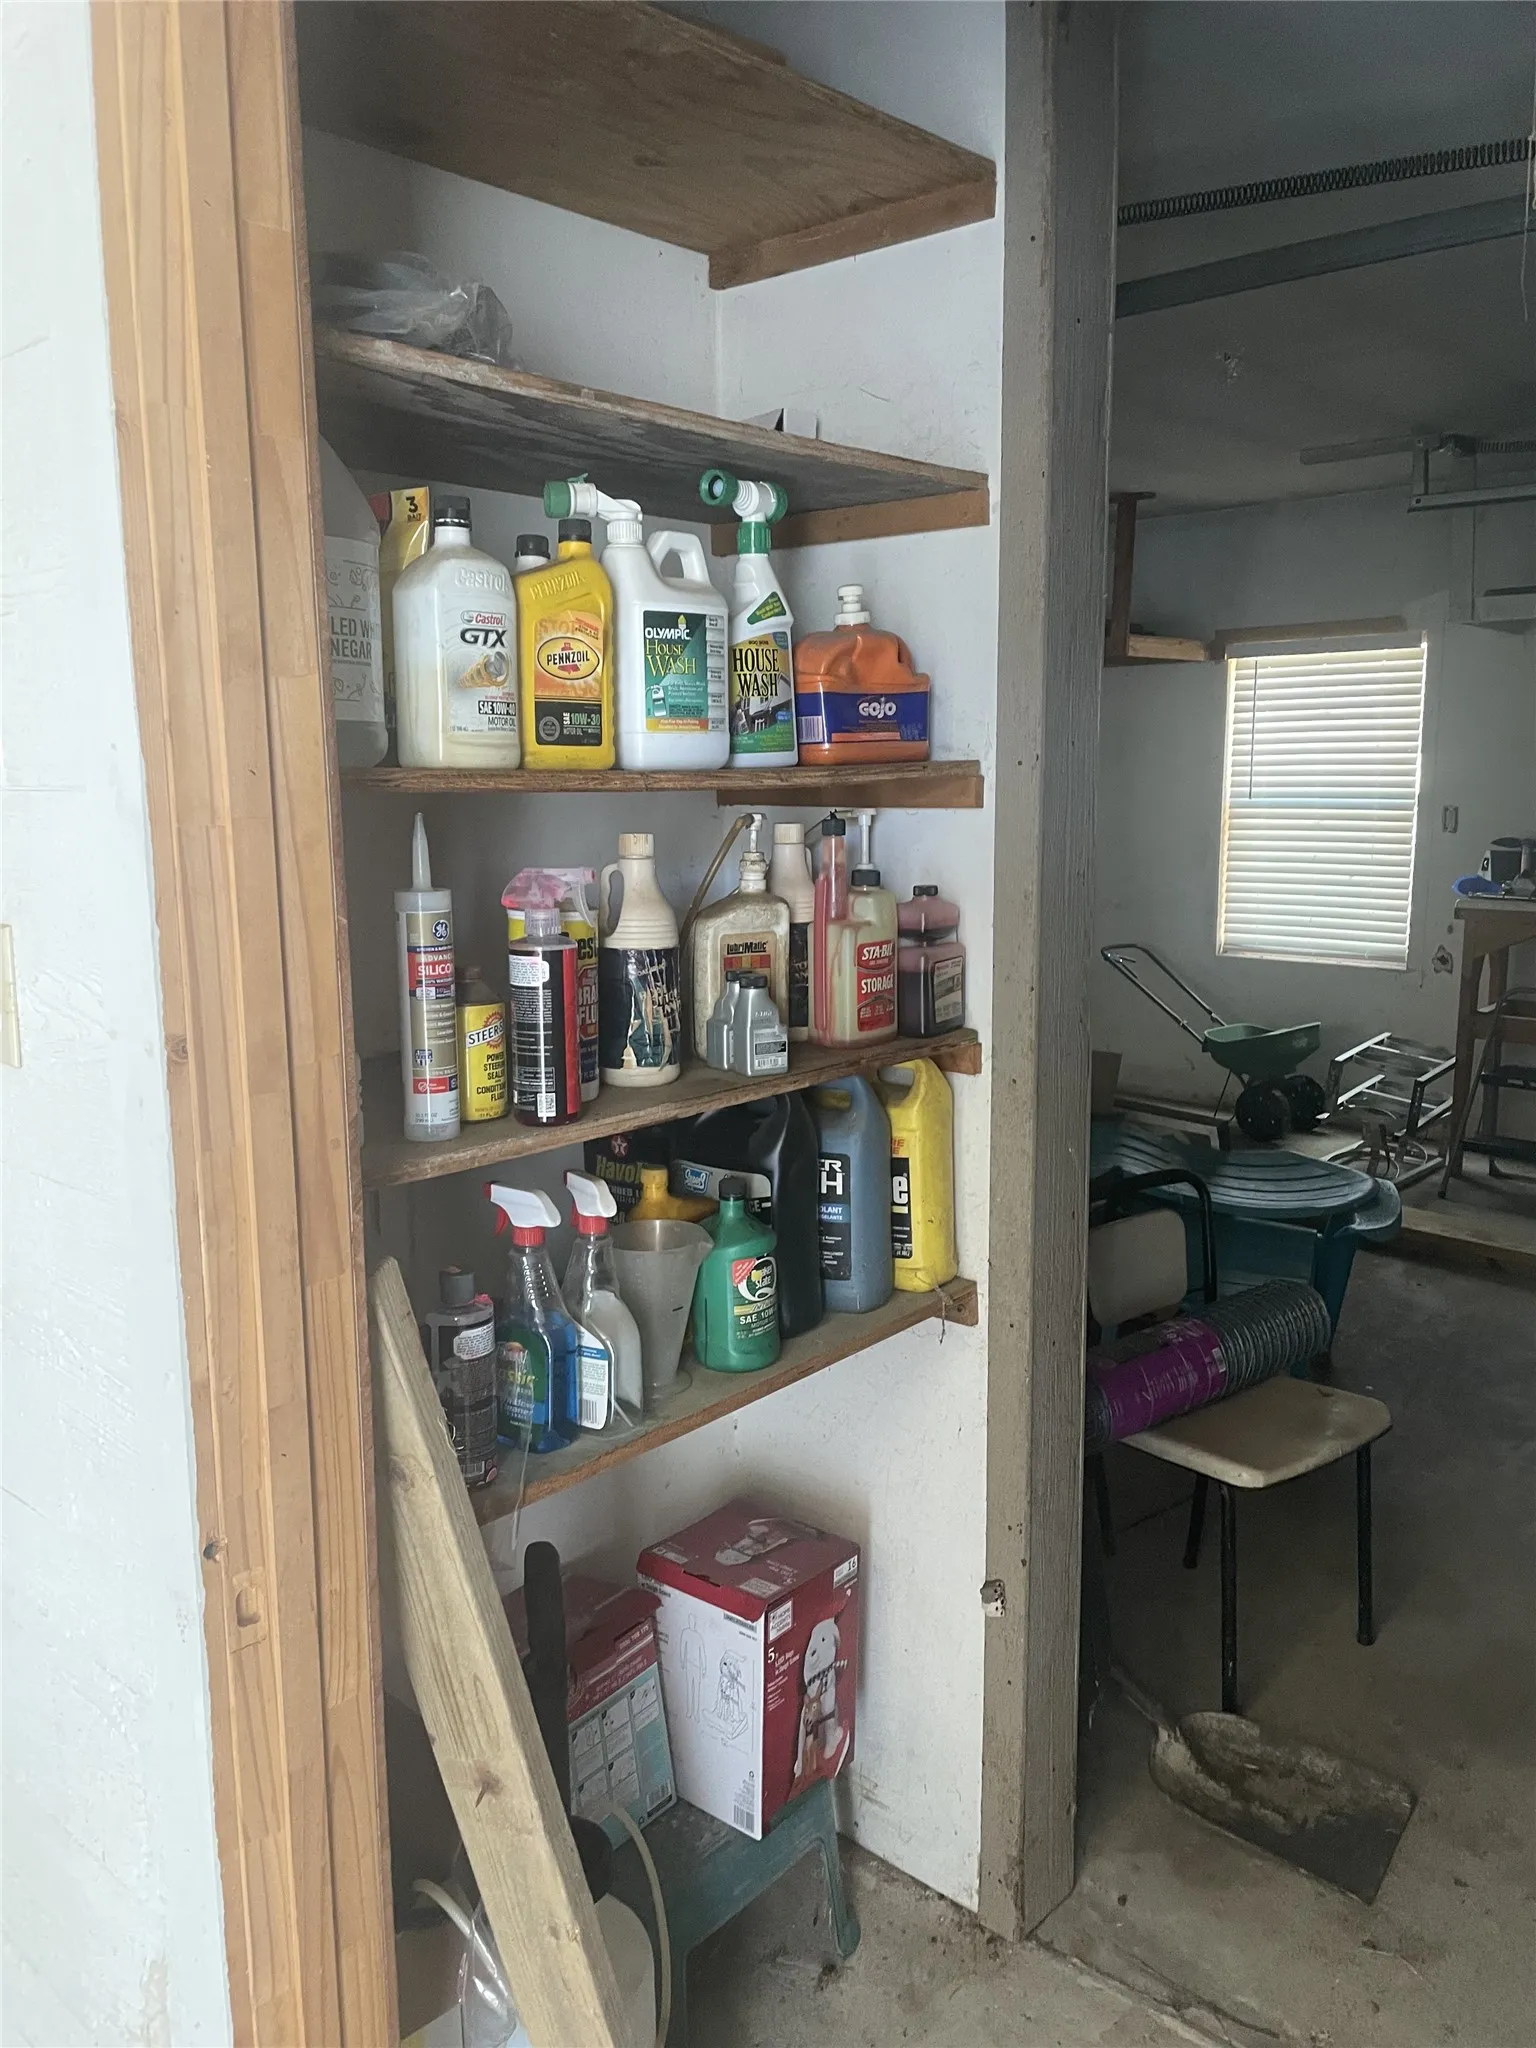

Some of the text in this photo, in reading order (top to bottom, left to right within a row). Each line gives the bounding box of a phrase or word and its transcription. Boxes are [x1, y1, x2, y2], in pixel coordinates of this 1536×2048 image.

[405, 495, 419, 514] 3
[455, 568, 507, 592] Castrol
[530, 571, 580, 600] PENNZOIL
[331, 616, 357, 637] LED
[475, 614, 503, 626] Castrol
[460, 628, 508, 648] GTX
[645, 627, 691, 640] OLYMPIC
[331, 638, 372, 660] NEGAR
[546, 650, 590, 666] PENNZOIL
[647, 655, 696, 677] WASH
[733, 649, 780, 672] HOUSE
[737, 673, 778, 697] WASH
[479, 701, 493, 714] SAE
[488, 716, 507, 727] MOTOR
[562, 712, 600, 726] SAE 10W-30
[861, 942, 893, 961] STA-BIL
[861, 974, 894, 995] STORAGE
[596, 1154, 647, 1184] Havol
[820, 1171, 843, 1195] H
[892, 1175, 908, 1204] e
[740, 1313, 758, 1325] SAE
[767, 1647, 775, 1664] 5
